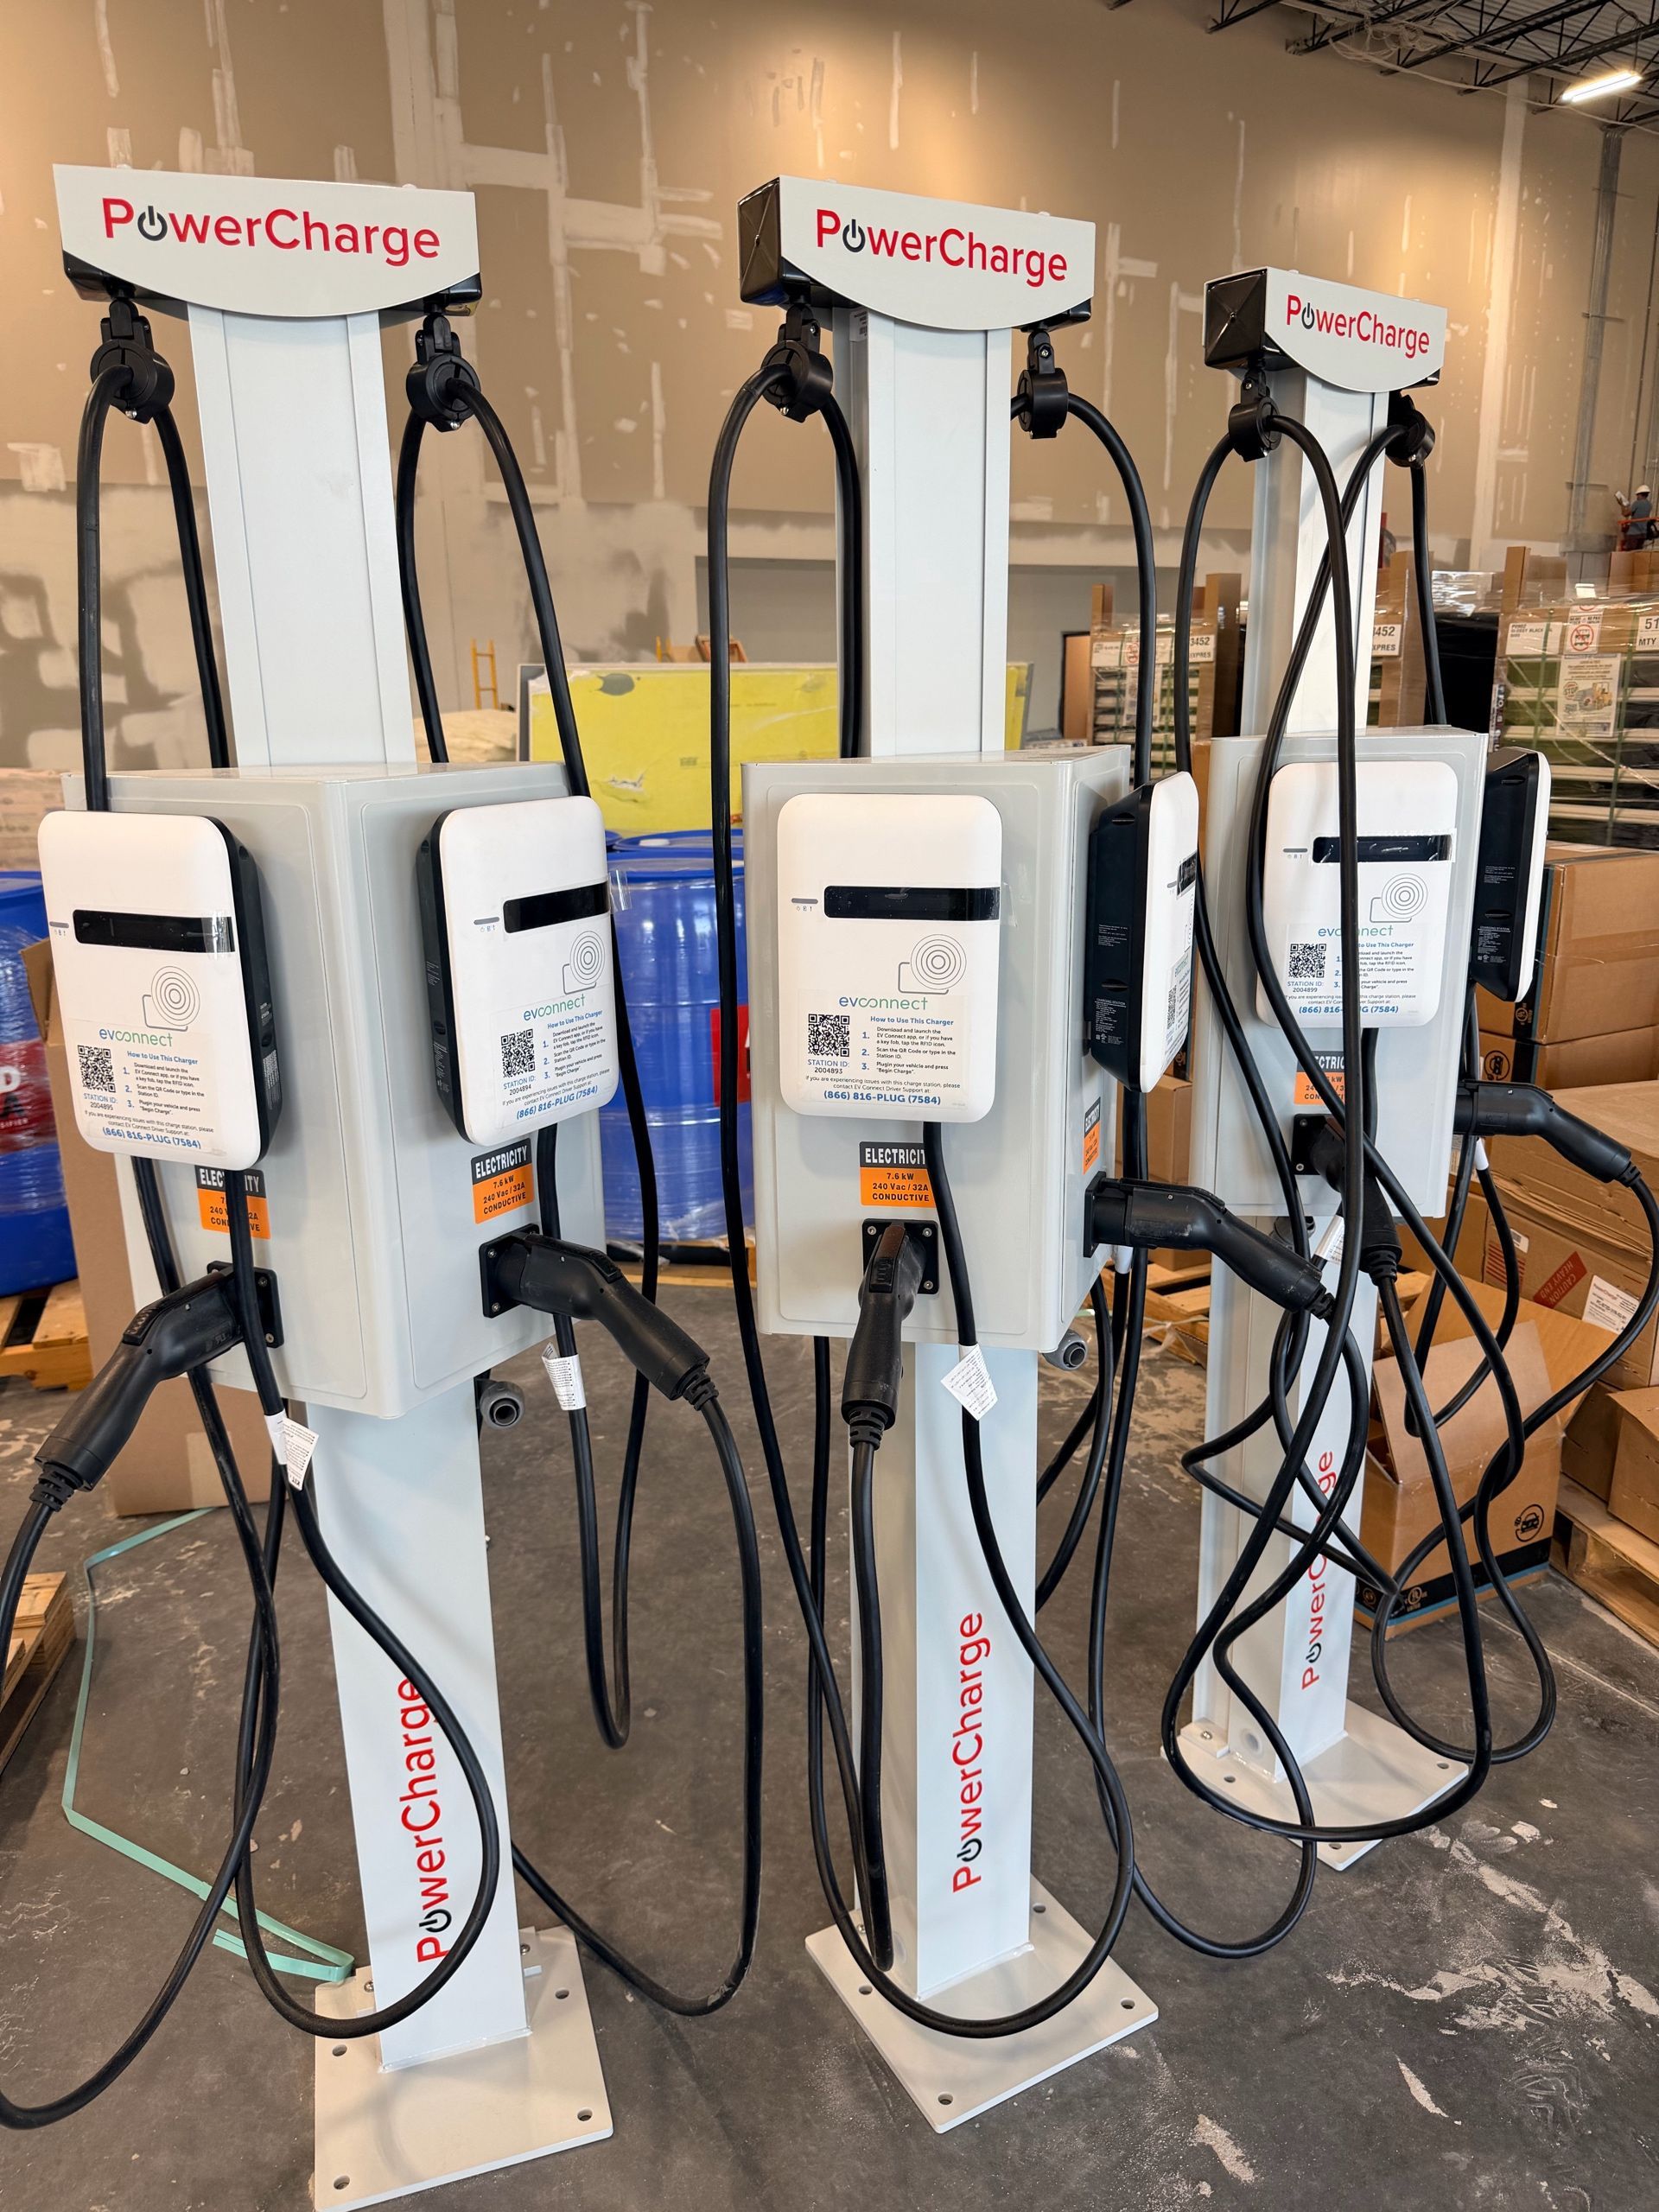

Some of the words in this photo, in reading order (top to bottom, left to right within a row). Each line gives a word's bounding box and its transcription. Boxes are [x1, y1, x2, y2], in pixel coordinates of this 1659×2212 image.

[101, 195, 441, 268] PowerCharge
[815, 208, 1069, 288] PowerCharge
[1286, 294, 1431, 359] PowerCharge
[524, 994, 586, 1021] evconnect
[839, 997, 928, 1010] evconnect
[99, 1028, 173, 1047] evconnect
[503, 1078, 527, 1090] STATION
[517, 1105, 537, 1120] (866)
[538, 1093, 575, 1112] 816-PLUG
[576, 1085, 598, 1100] (7584)
[824, 1090, 850, 1101] (866)
[854, 1092, 906, 1103] 816-PLUG
[908, 1096, 941, 1105] (7584)
[102, 1127, 125, 1139] (866)
[127, 1132, 171, 1145] 816-PLUG
[173, 1137, 201, 1149] (7584)
[475, 1145, 527, 1179] ELECTRICITY
[865, 1147, 925, 1165] ELECTRICIT
[200, 1168, 259, 1192] ELECITY
[493, 1179, 504, 1189] 7.6
[505, 1175, 514, 1185] kW
[484, 1194, 495, 1205] 240
[496, 1189, 509, 1199] Vac
[513, 1182, 525, 1192] 32A
[484, 1192, 526, 1214] CONDUCTIVE
[873, 1192, 930, 1202] CONDUCTIVE
[210, 1206, 223, 1215] 240
[1301, 1451, 1336, 1689] PowerCge
[952, 1611, 991, 1893] PowerCharge
